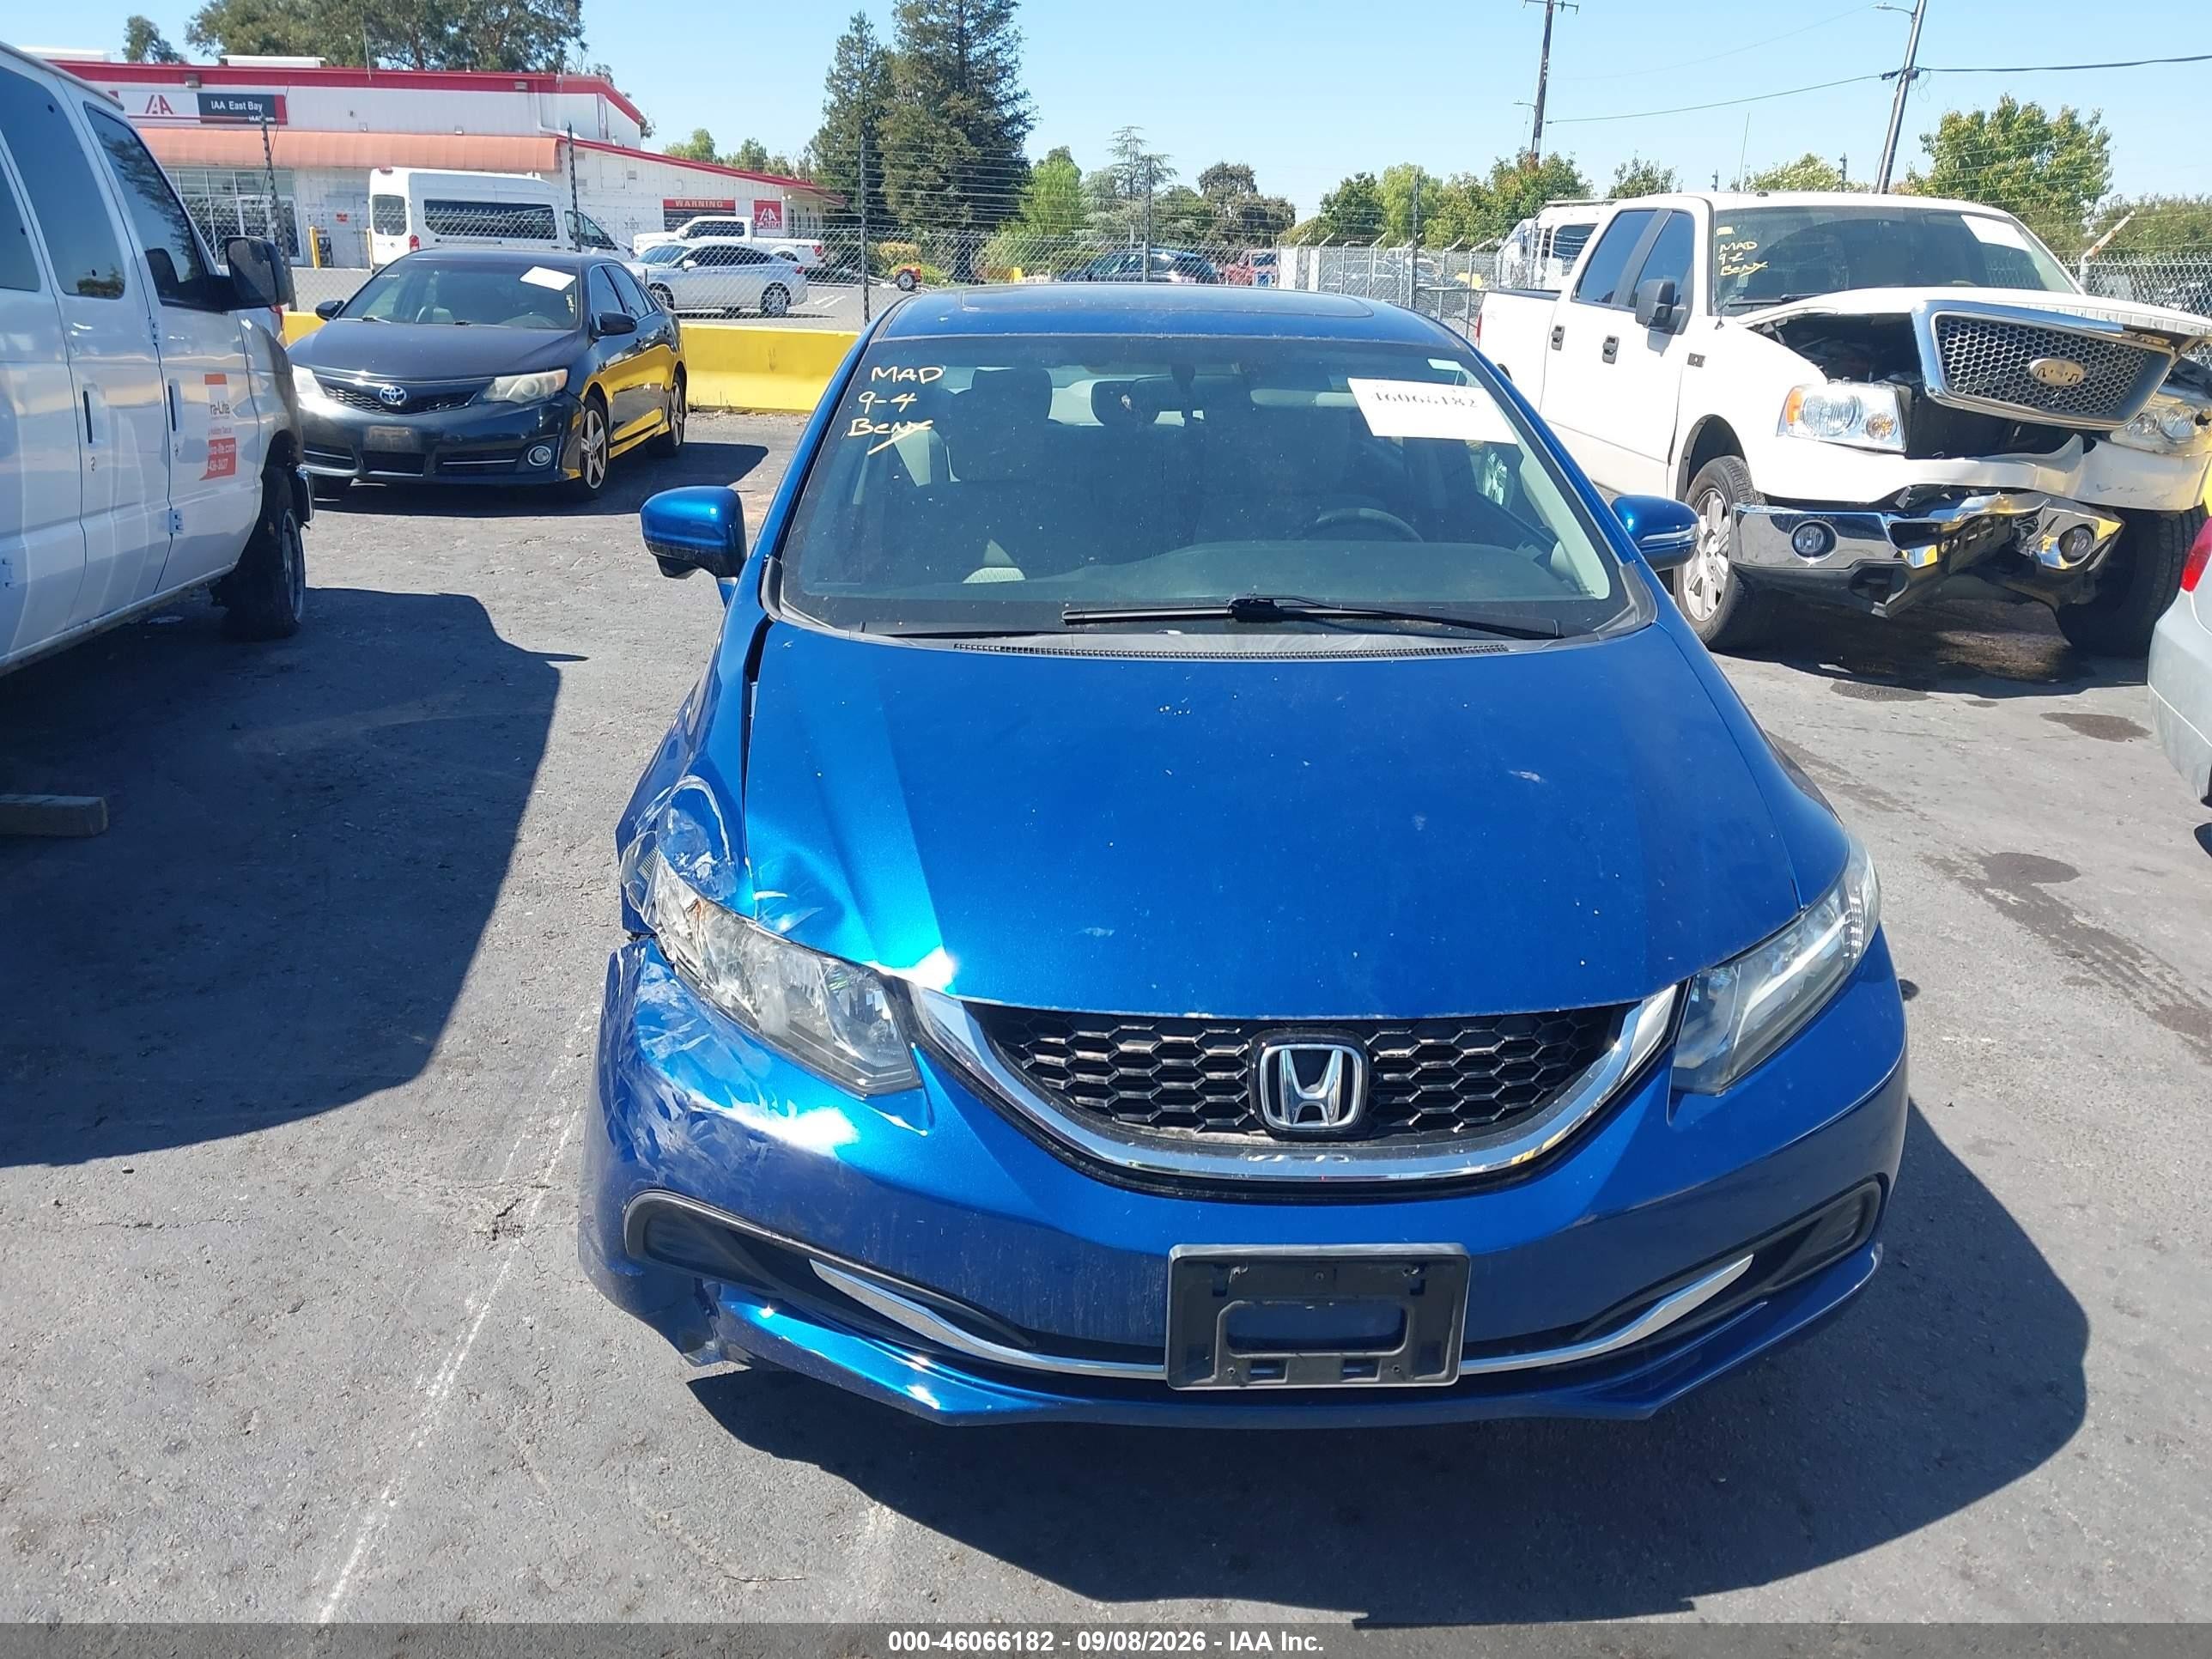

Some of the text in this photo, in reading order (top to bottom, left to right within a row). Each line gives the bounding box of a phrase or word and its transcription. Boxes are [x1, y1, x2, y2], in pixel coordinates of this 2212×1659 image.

[210, 100, 263, 112] IAA East Bay
[675, 199, 723, 208] WARNING
[1719, 241, 1758, 253] MAD
[871, 366, 944, 385] MAD
[858, 391, 918, 414] 9-4
